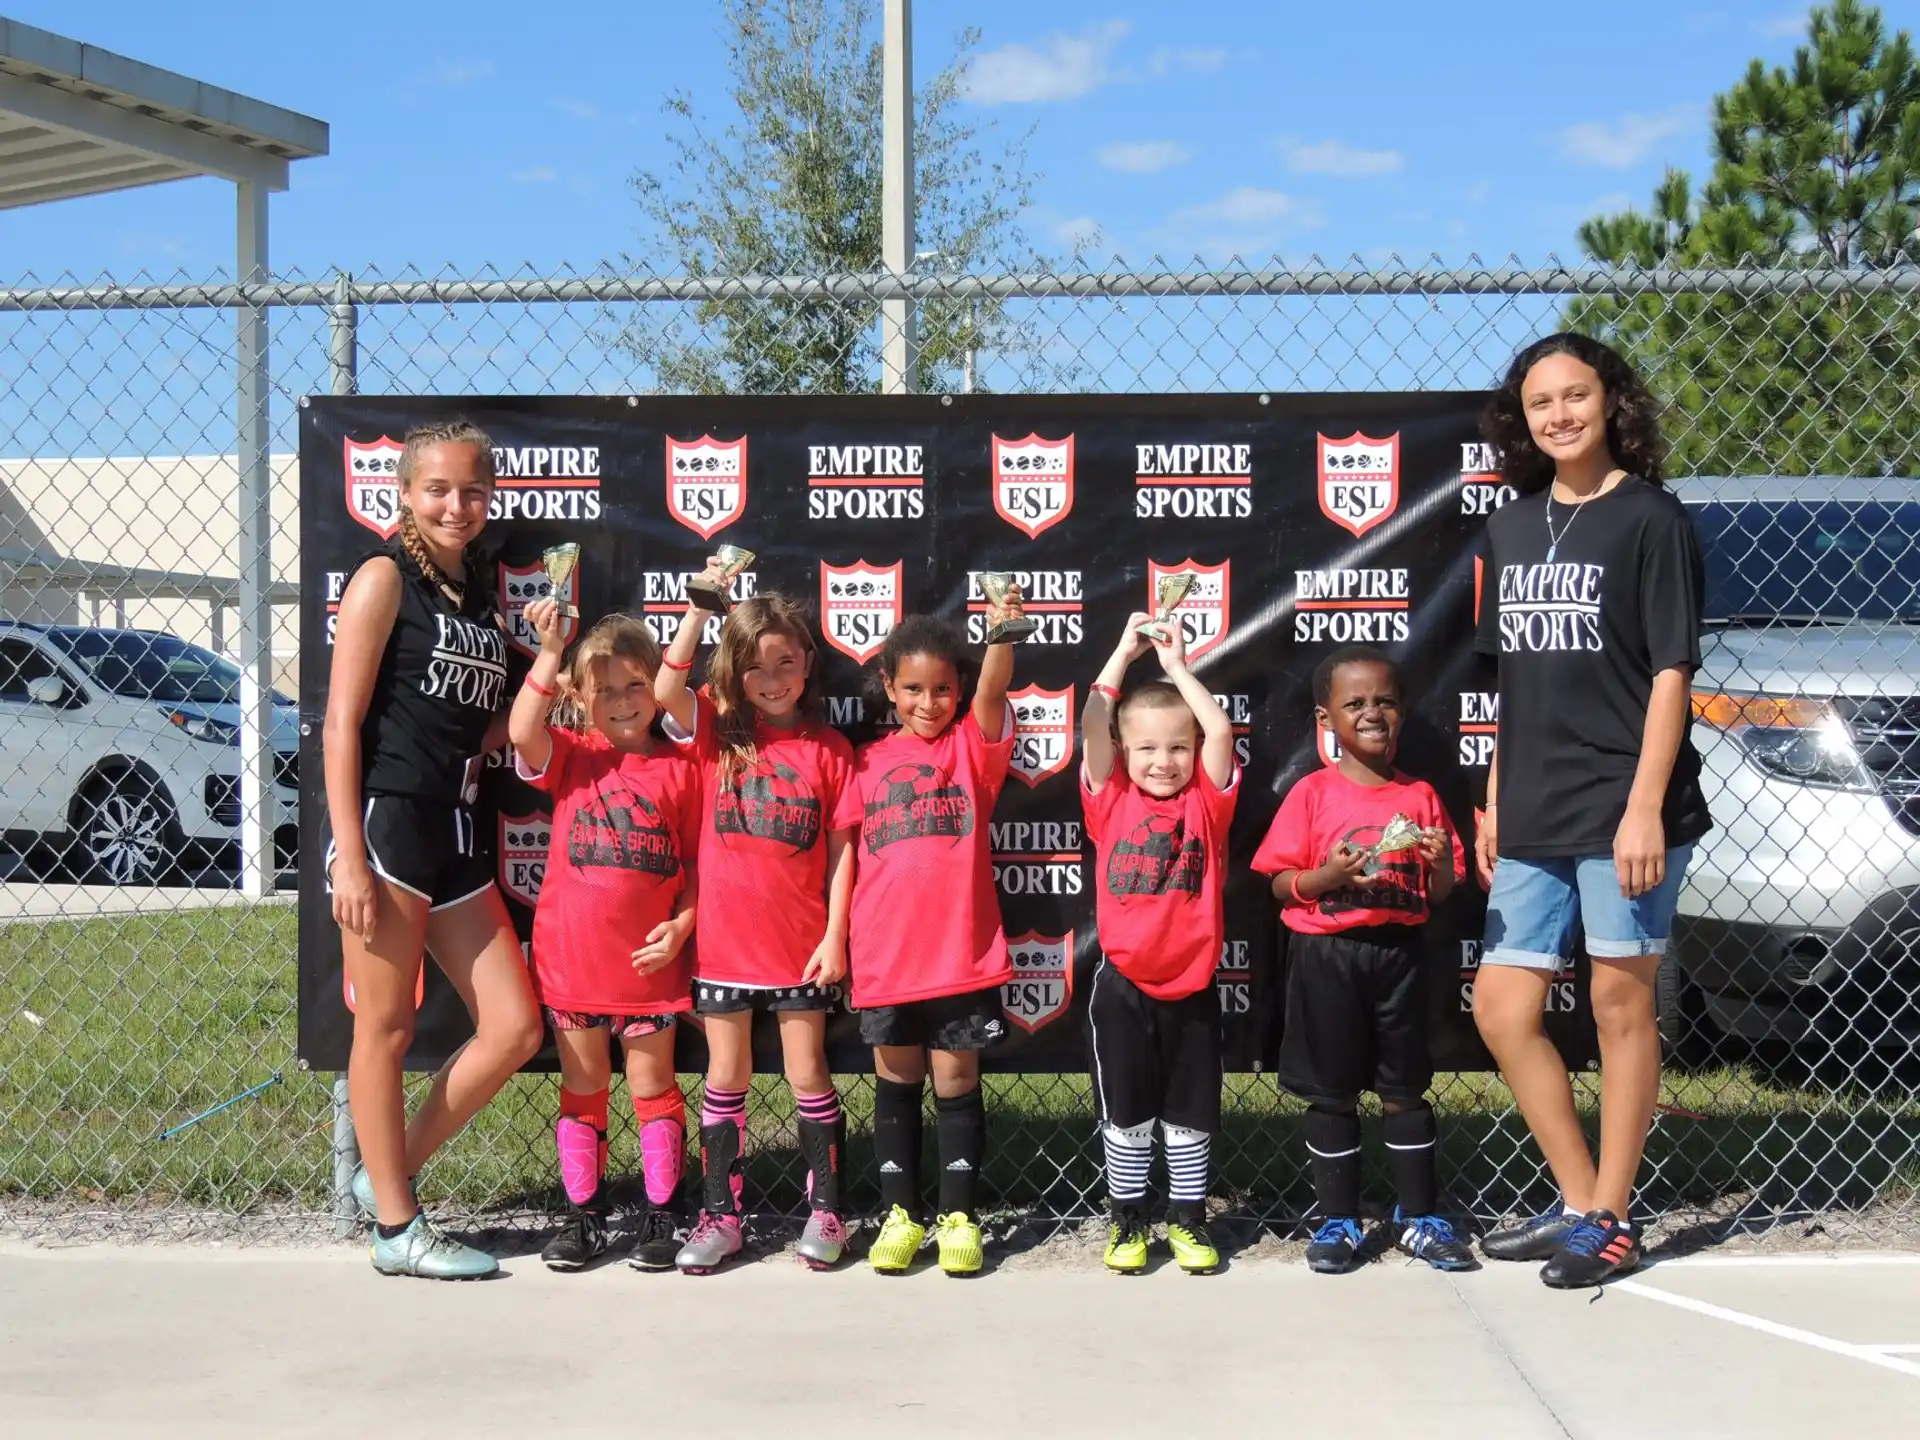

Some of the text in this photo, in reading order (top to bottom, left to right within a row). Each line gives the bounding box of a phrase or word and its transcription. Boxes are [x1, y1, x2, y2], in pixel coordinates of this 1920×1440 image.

[491, 447, 599, 476] EMPIRE
[808, 446, 923, 475] EMPIRE
[1135, 444, 1251, 474] EMPIRE
[360, 488, 401, 520] ES
[487, 489, 600, 520] SPORTS
[681, 488, 733, 520] ESL
[808, 489, 924, 519] SPORTS
[1007, 487, 1060, 519] ESL
[1136, 487, 1252, 518] SPORTS
[1332, 485, 1385, 518] ESL
[967, 571, 1083, 601] EPIRE
[1295, 569, 1408, 599] EMPIRE
[1499, 563, 1604, 603] EMPIRE
[836, 613, 889, 645] ESL
[967, 614, 1083, 644] SRTS
[1294, 612, 1409, 642] SPORTS
[1499, 612, 1603, 653] SPORTS
[420, 658, 506, 712] SPORT
[989, 822, 1082, 851] MPIRE
[512, 862, 546, 896] ES
[993, 864, 1083, 895] ORTS
[1006, 984, 1059, 1015] ESL
